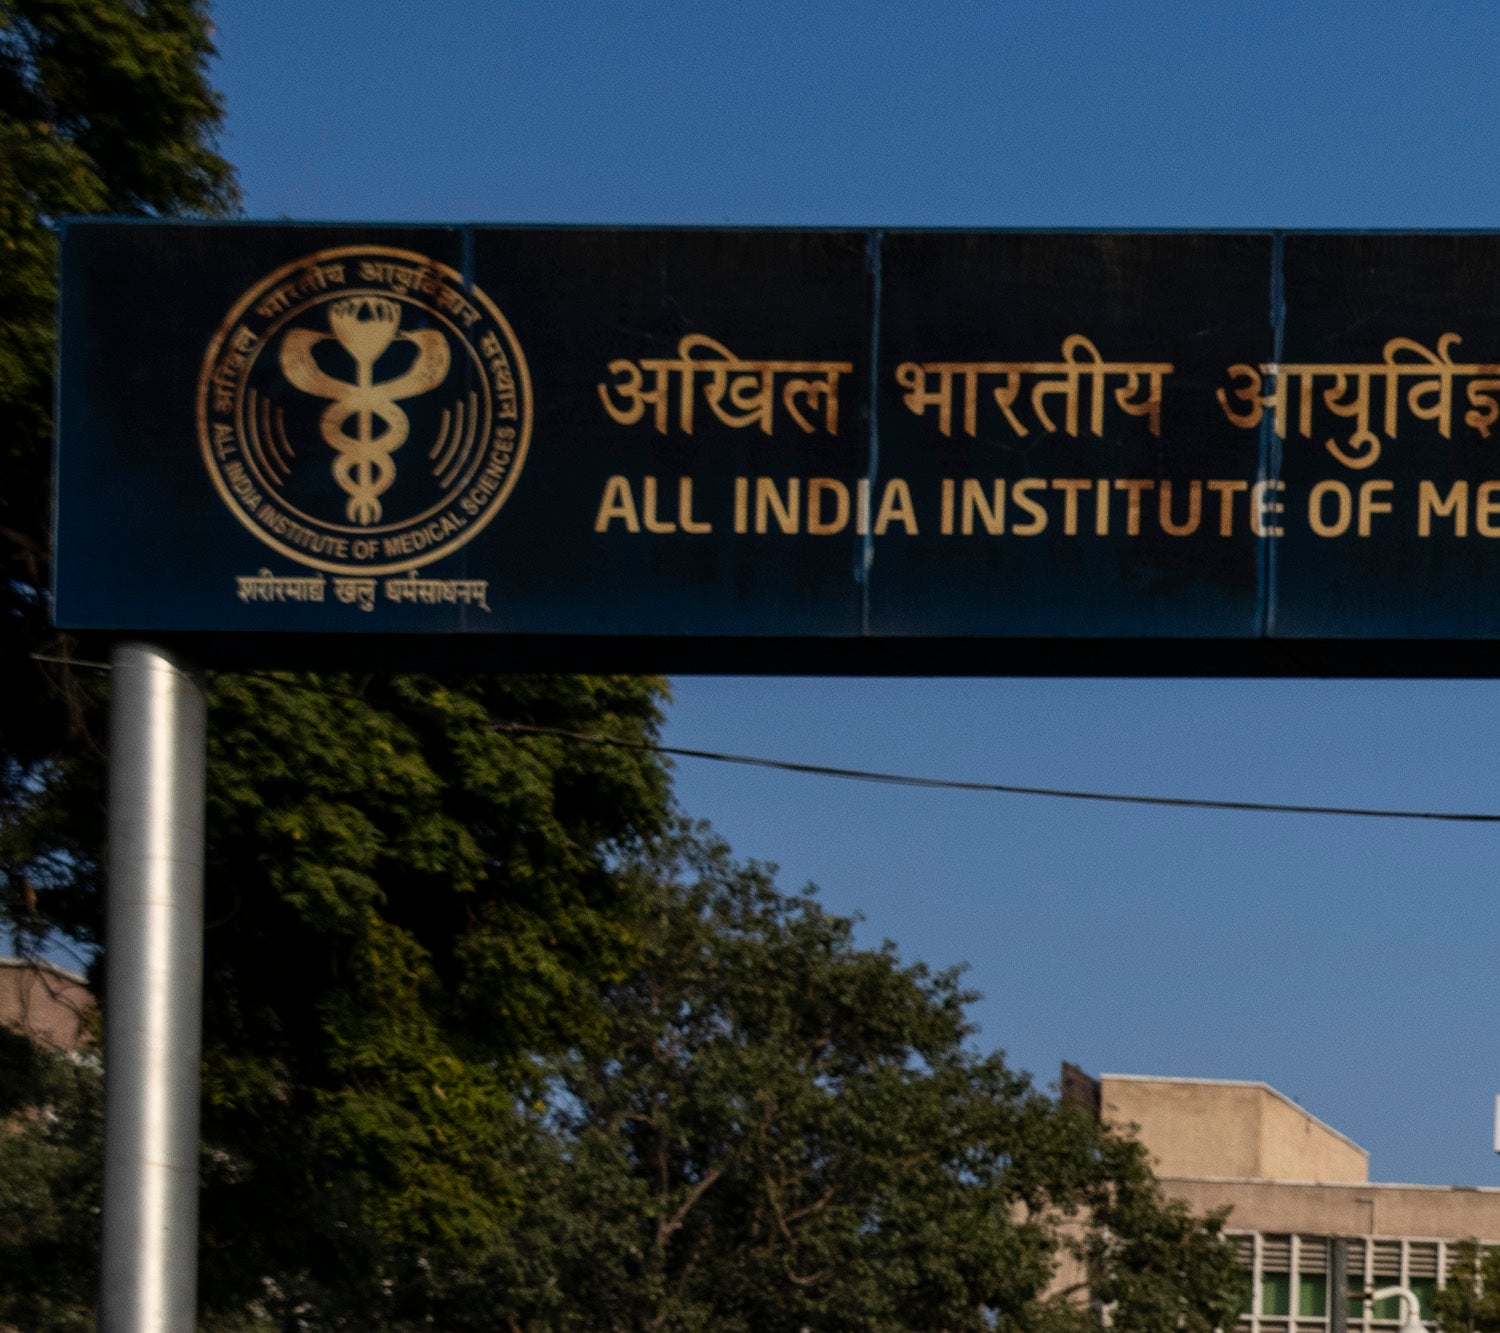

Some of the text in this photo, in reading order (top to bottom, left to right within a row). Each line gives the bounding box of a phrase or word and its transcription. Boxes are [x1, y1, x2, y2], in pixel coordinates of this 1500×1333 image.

[596, 335, 851, 438] अखिल
[896, 335, 1172, 438] भारतीय
[213, 421, 517, 560] ALL INDIA INSTITUTE OF MEDICAL SCIENCES
[596, 475, 713, 536] ALL
[734, 475, 920, 536] INDIA
[939, 477, 1286, 538] INSTITUTE
[1308, 478, 1396, 539] OF
